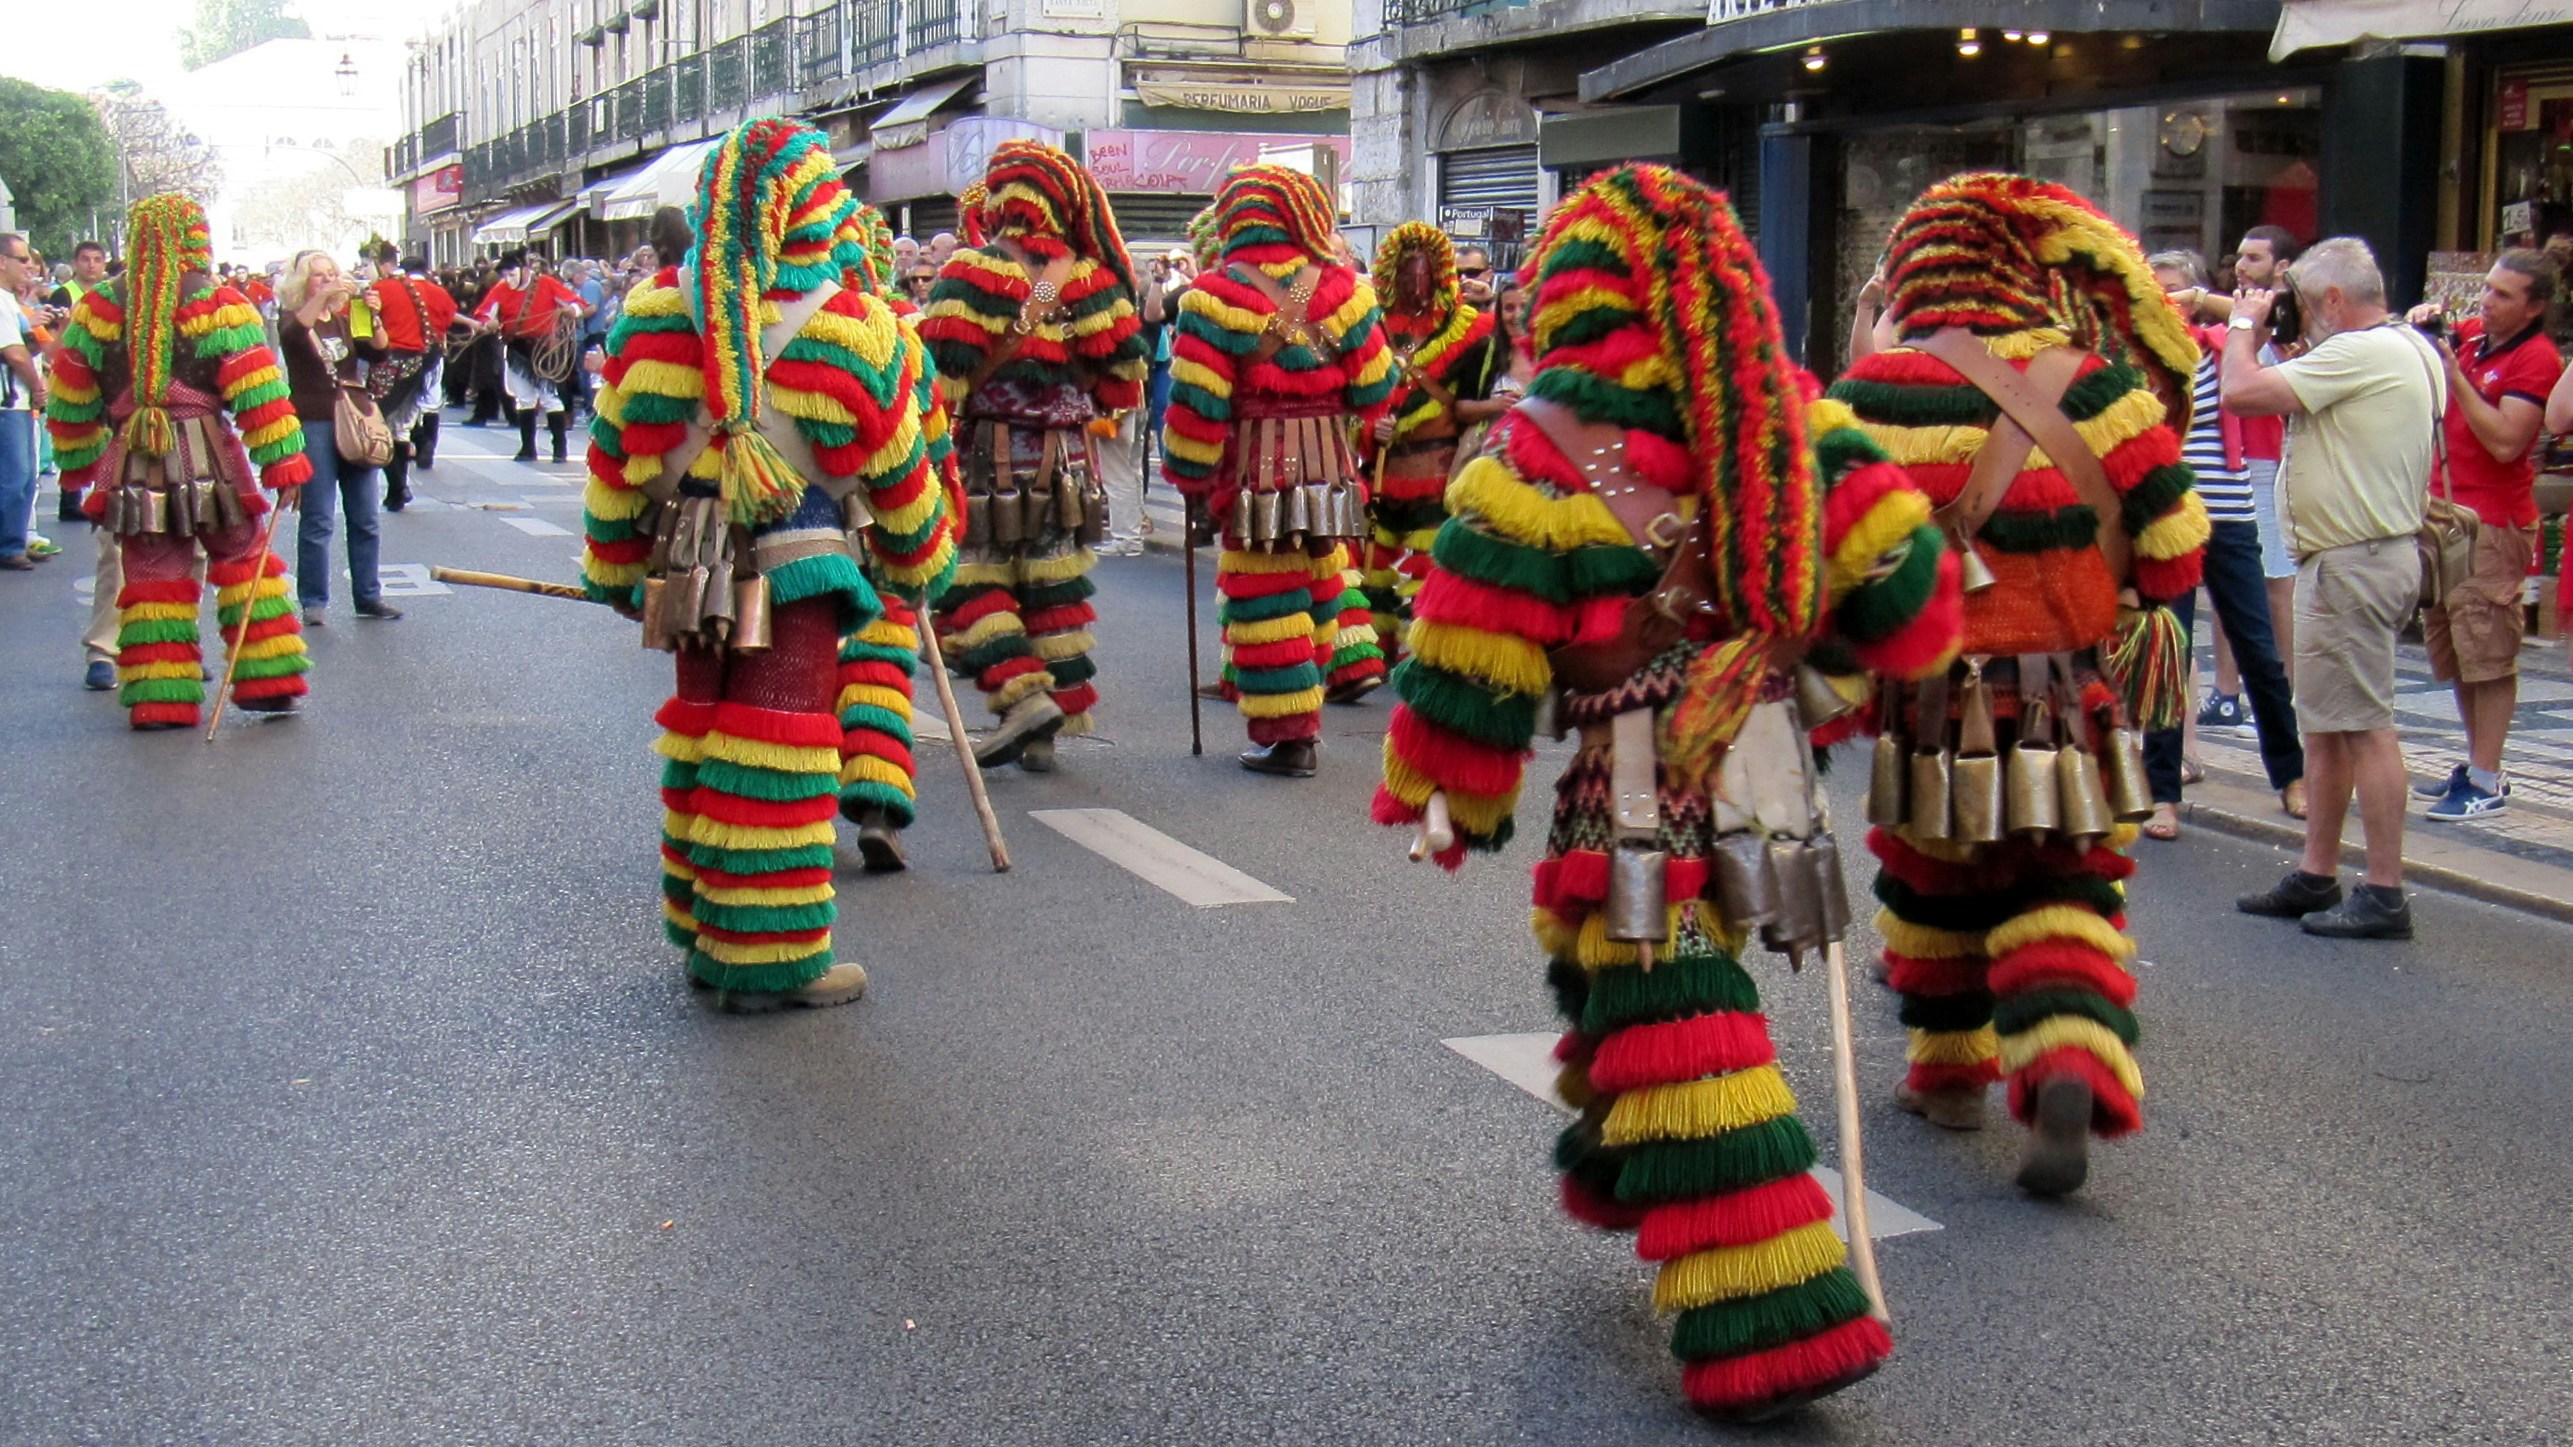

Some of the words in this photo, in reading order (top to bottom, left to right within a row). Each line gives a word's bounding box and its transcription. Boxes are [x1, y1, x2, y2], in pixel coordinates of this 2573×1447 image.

[1183, 92, 1271, 110] PERFUMARIA
[1288, 95, 1332, 110] VOGUE
[1451, 208, 1490, 219] Portugal
